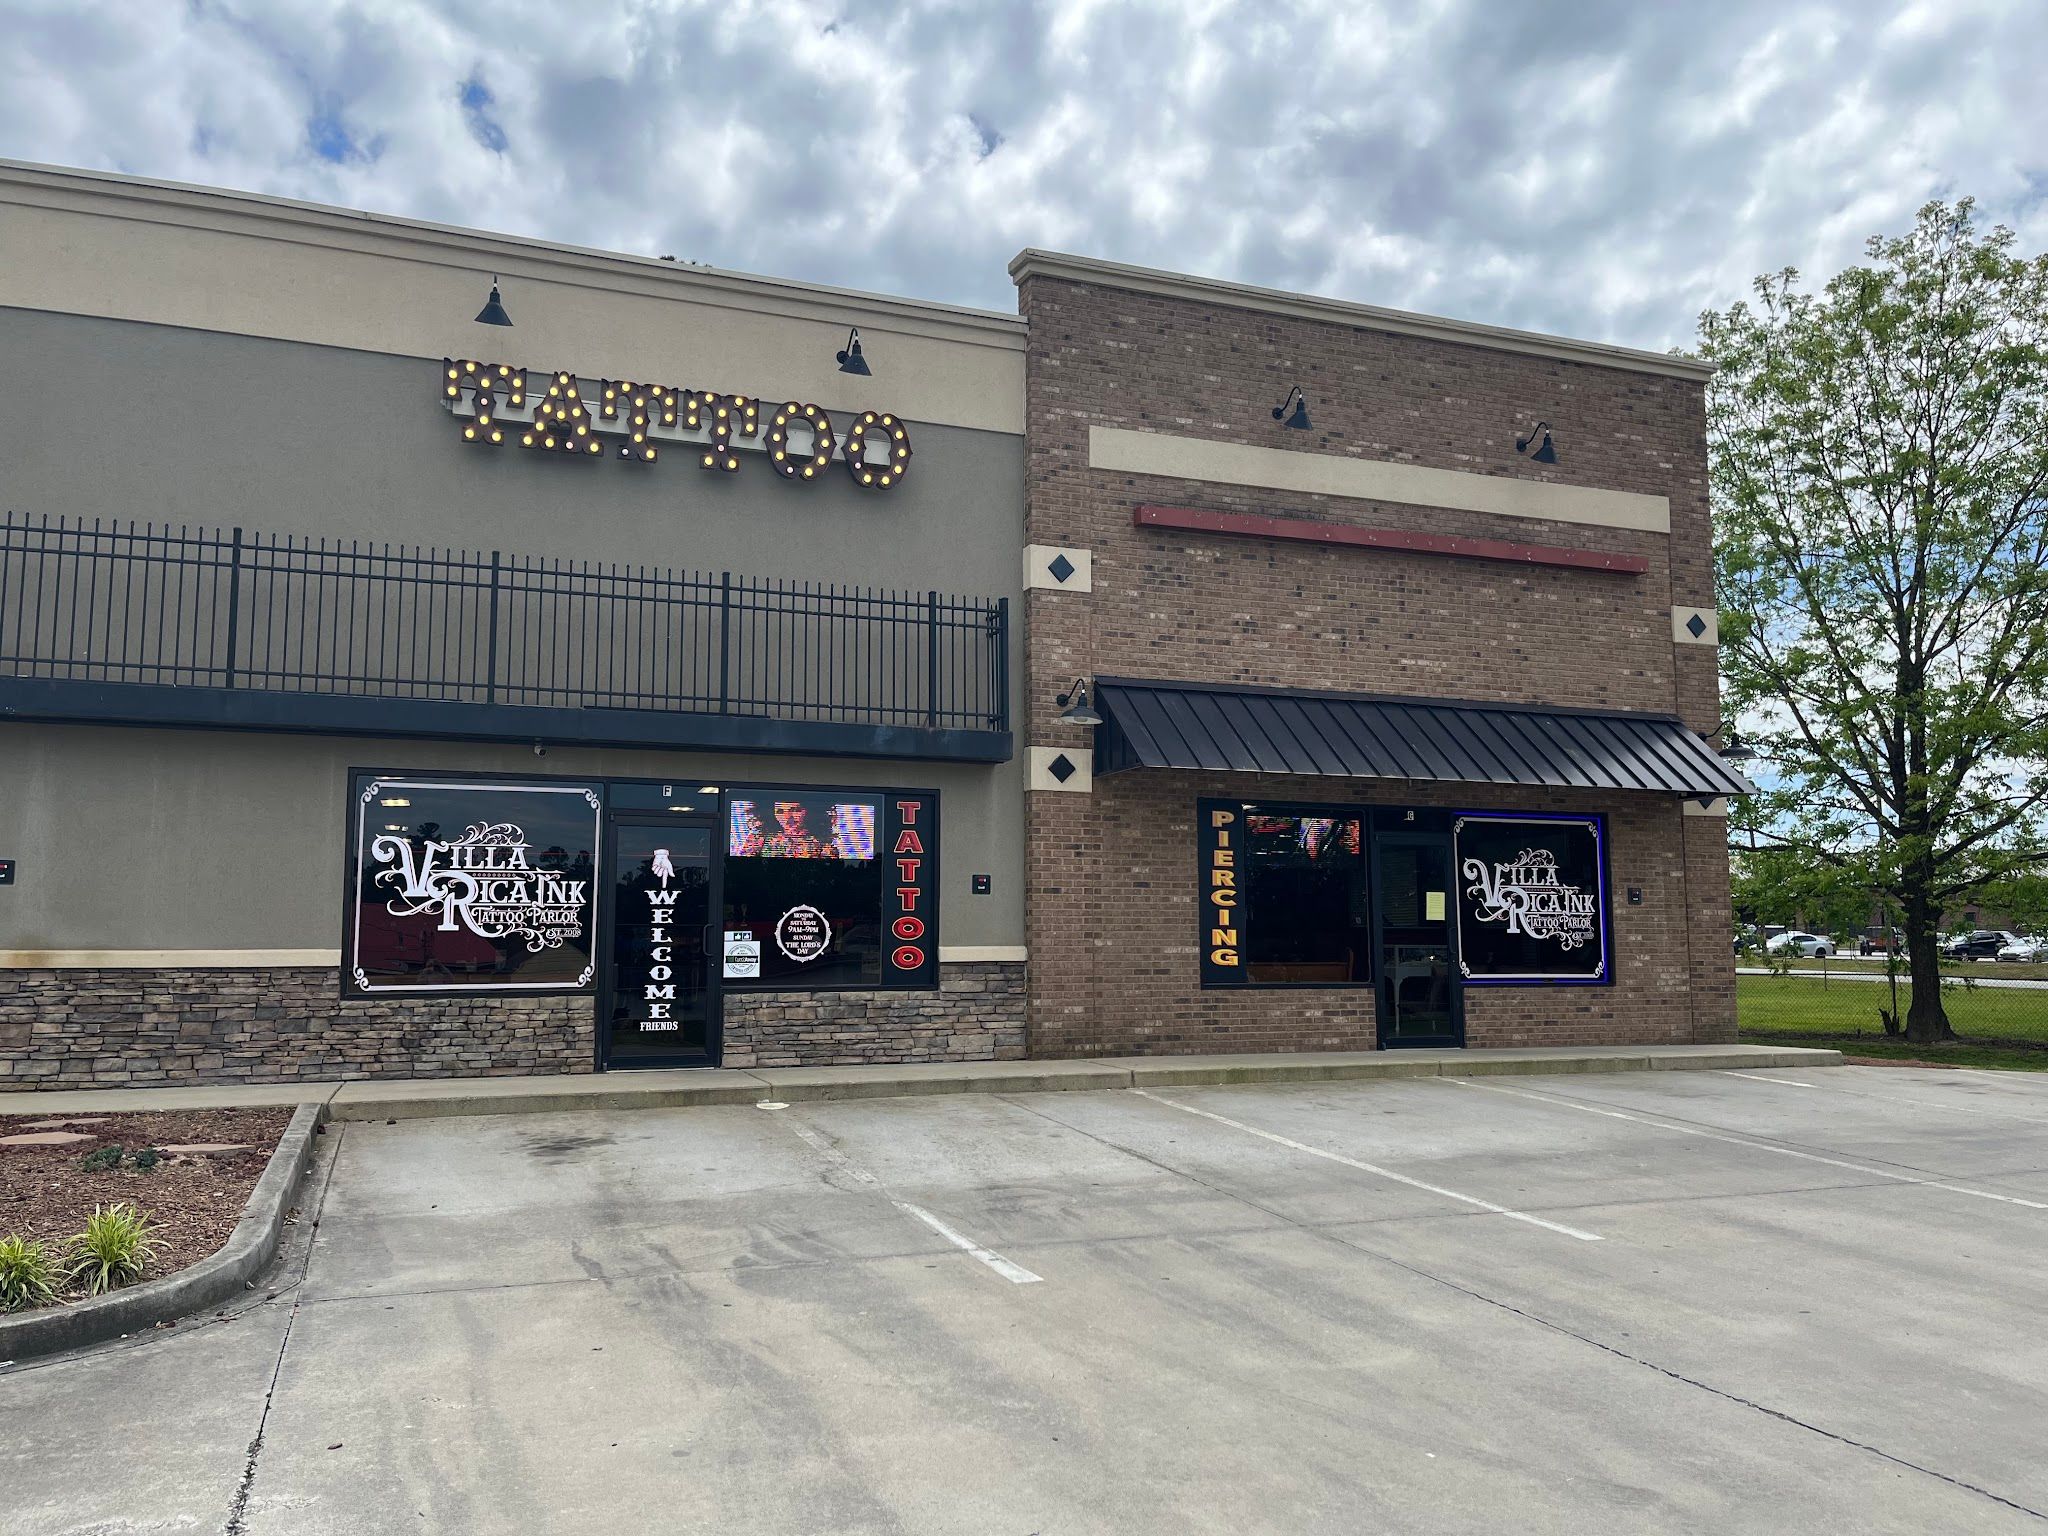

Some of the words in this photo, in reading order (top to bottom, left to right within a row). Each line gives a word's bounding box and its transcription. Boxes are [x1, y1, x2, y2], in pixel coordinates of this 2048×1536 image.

[443, 357, 913, 490] TATTOO
[664, 786, 671, 796] F
[372, 834, 530, 897] VILLA
[891, 801, 925, 970] TATTOO
[1210, 810, 1239, 967] PIERCING
[1463, 857, 1560, 907] VILLA
[427, 869, 532, 937] RICA
[531, 873, 587, 908] INK
[472, 906, 525, 926] TATTOO
[526, 906, 579, 926] PARLOR
[1499, 886, 1562, 939] RICA
[1561, 886, 1596, 916] INK
[1526, 915, 1559, 929] TATTOO
[643, 889, 682, 1019] WELCOME
[640, 1020, 679, 1032] FRIENDS
